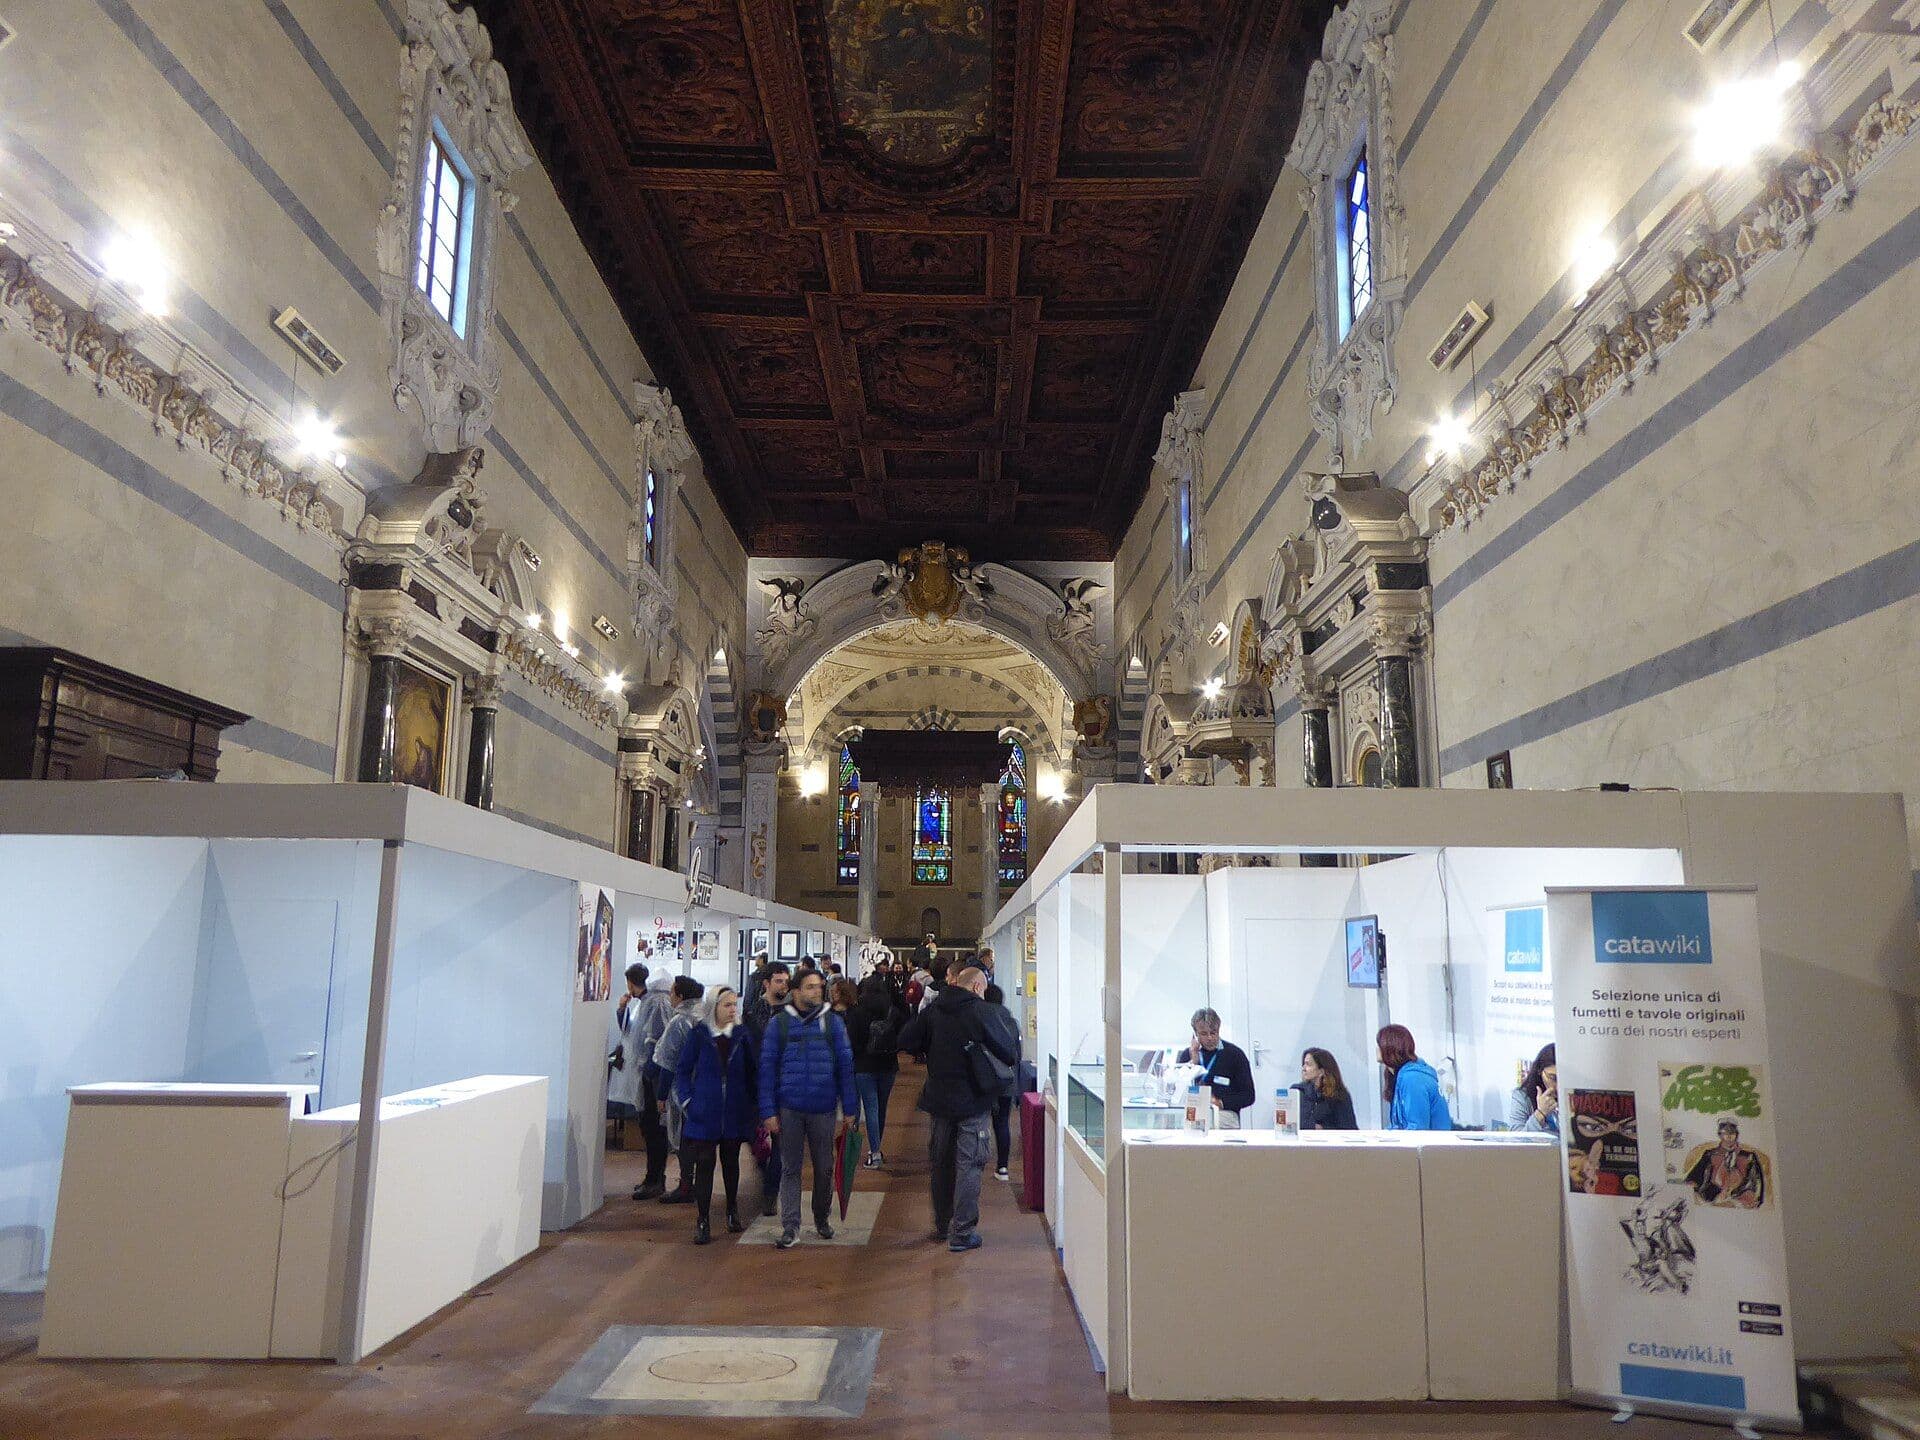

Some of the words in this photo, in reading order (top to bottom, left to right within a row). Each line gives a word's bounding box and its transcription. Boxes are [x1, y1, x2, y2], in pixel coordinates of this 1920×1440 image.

[654, 916, 663, 930] 9
[1604, 935, 1701, 954] catawiki
[1507, 948, 1541, 964] catawiki
[1592, 989, 1660, 1002] Selezione
[1664, 991, 1703, 1002] unica
[1707, 990, 1721, 1003] di
[1572, 1006, 1621, 1019] fumetti
[1625, 1009, 1634, 1019] e
[1638, 1008, 1682, 1019] tavole
[1685, 1008, 1746, 1023] originali
[1578, 1025, 1586, 1035] a
[1590, 1025, 1619, 1036] cura
[1623, 1024, 1645, 1037] dei
[1649, 1027, 1688, 1038] nostri
[1691, 1027, 1741, 1041] esperti
[1628, 1341, 1734, 1366] catawiki.it
